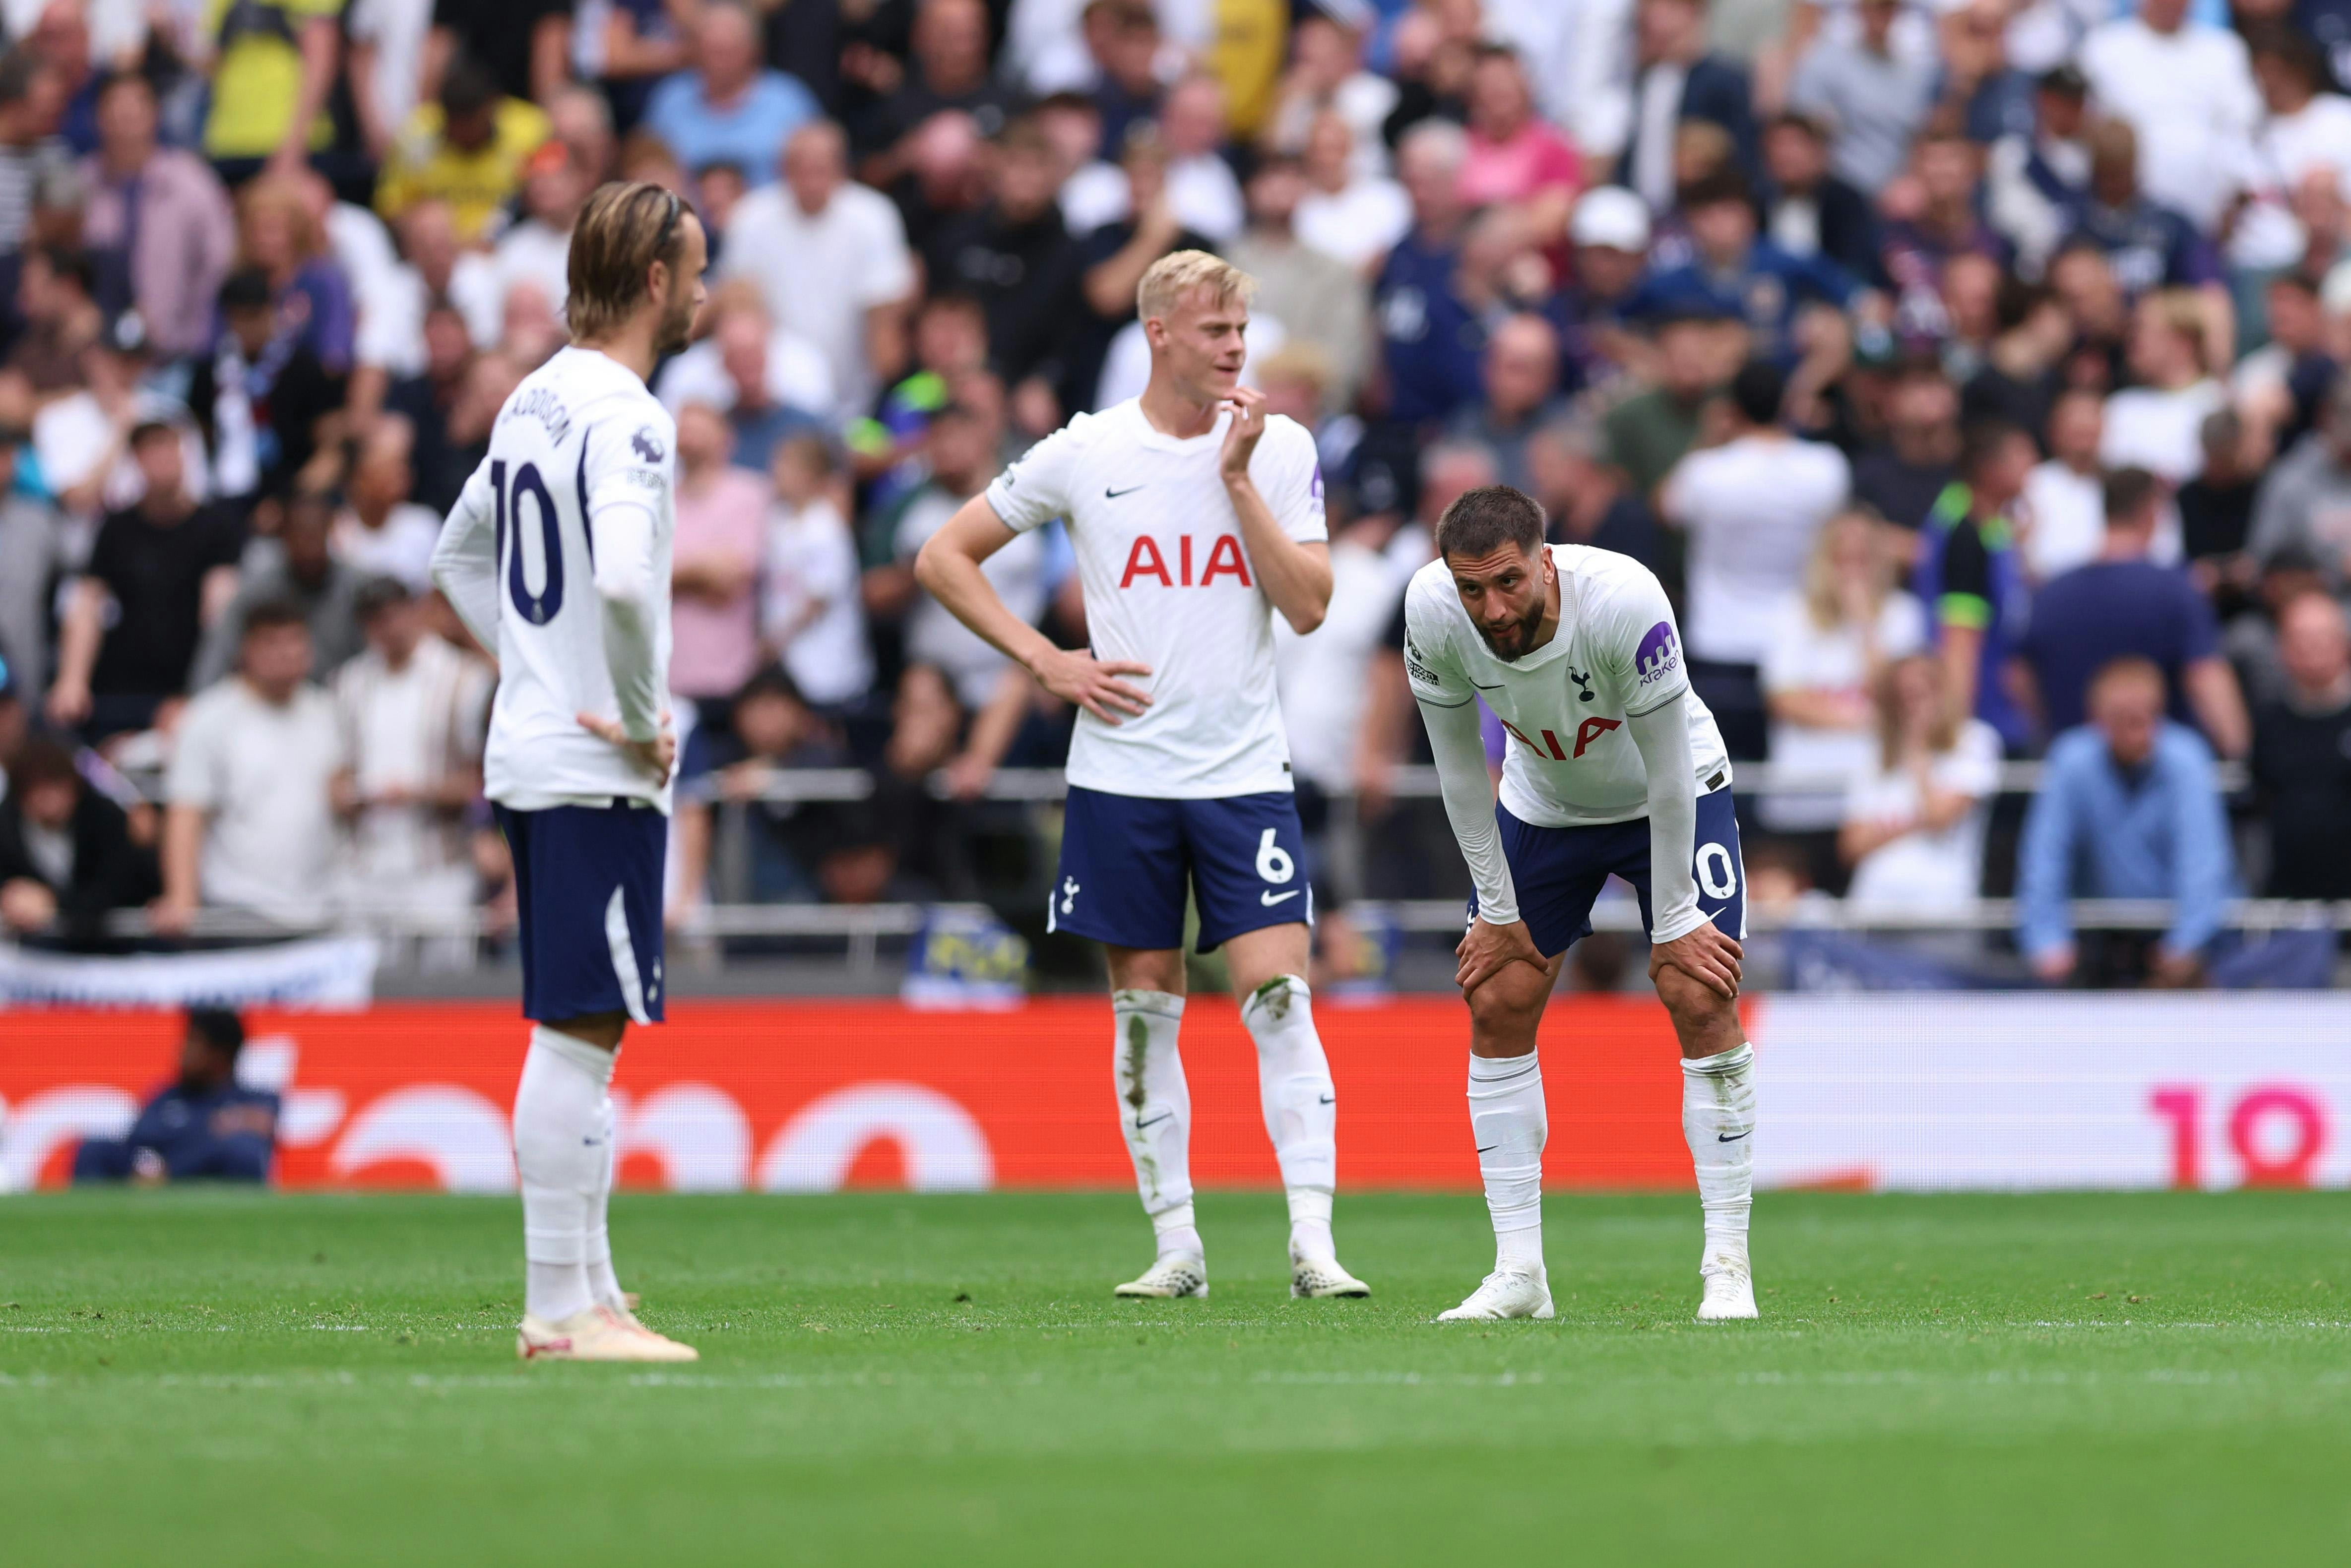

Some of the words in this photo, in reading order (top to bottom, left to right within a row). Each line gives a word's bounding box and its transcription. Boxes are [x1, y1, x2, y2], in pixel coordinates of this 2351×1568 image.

[491, 459, 564, 626] 10
[1119, 534, 1252, 588] AIA
[1640, 649, 1681, 688] kraken
[1501, 716, 1623, 760] AIA
[1256, 827, 1294, 884] 6
[1692, 842, 1736, 905] 0
